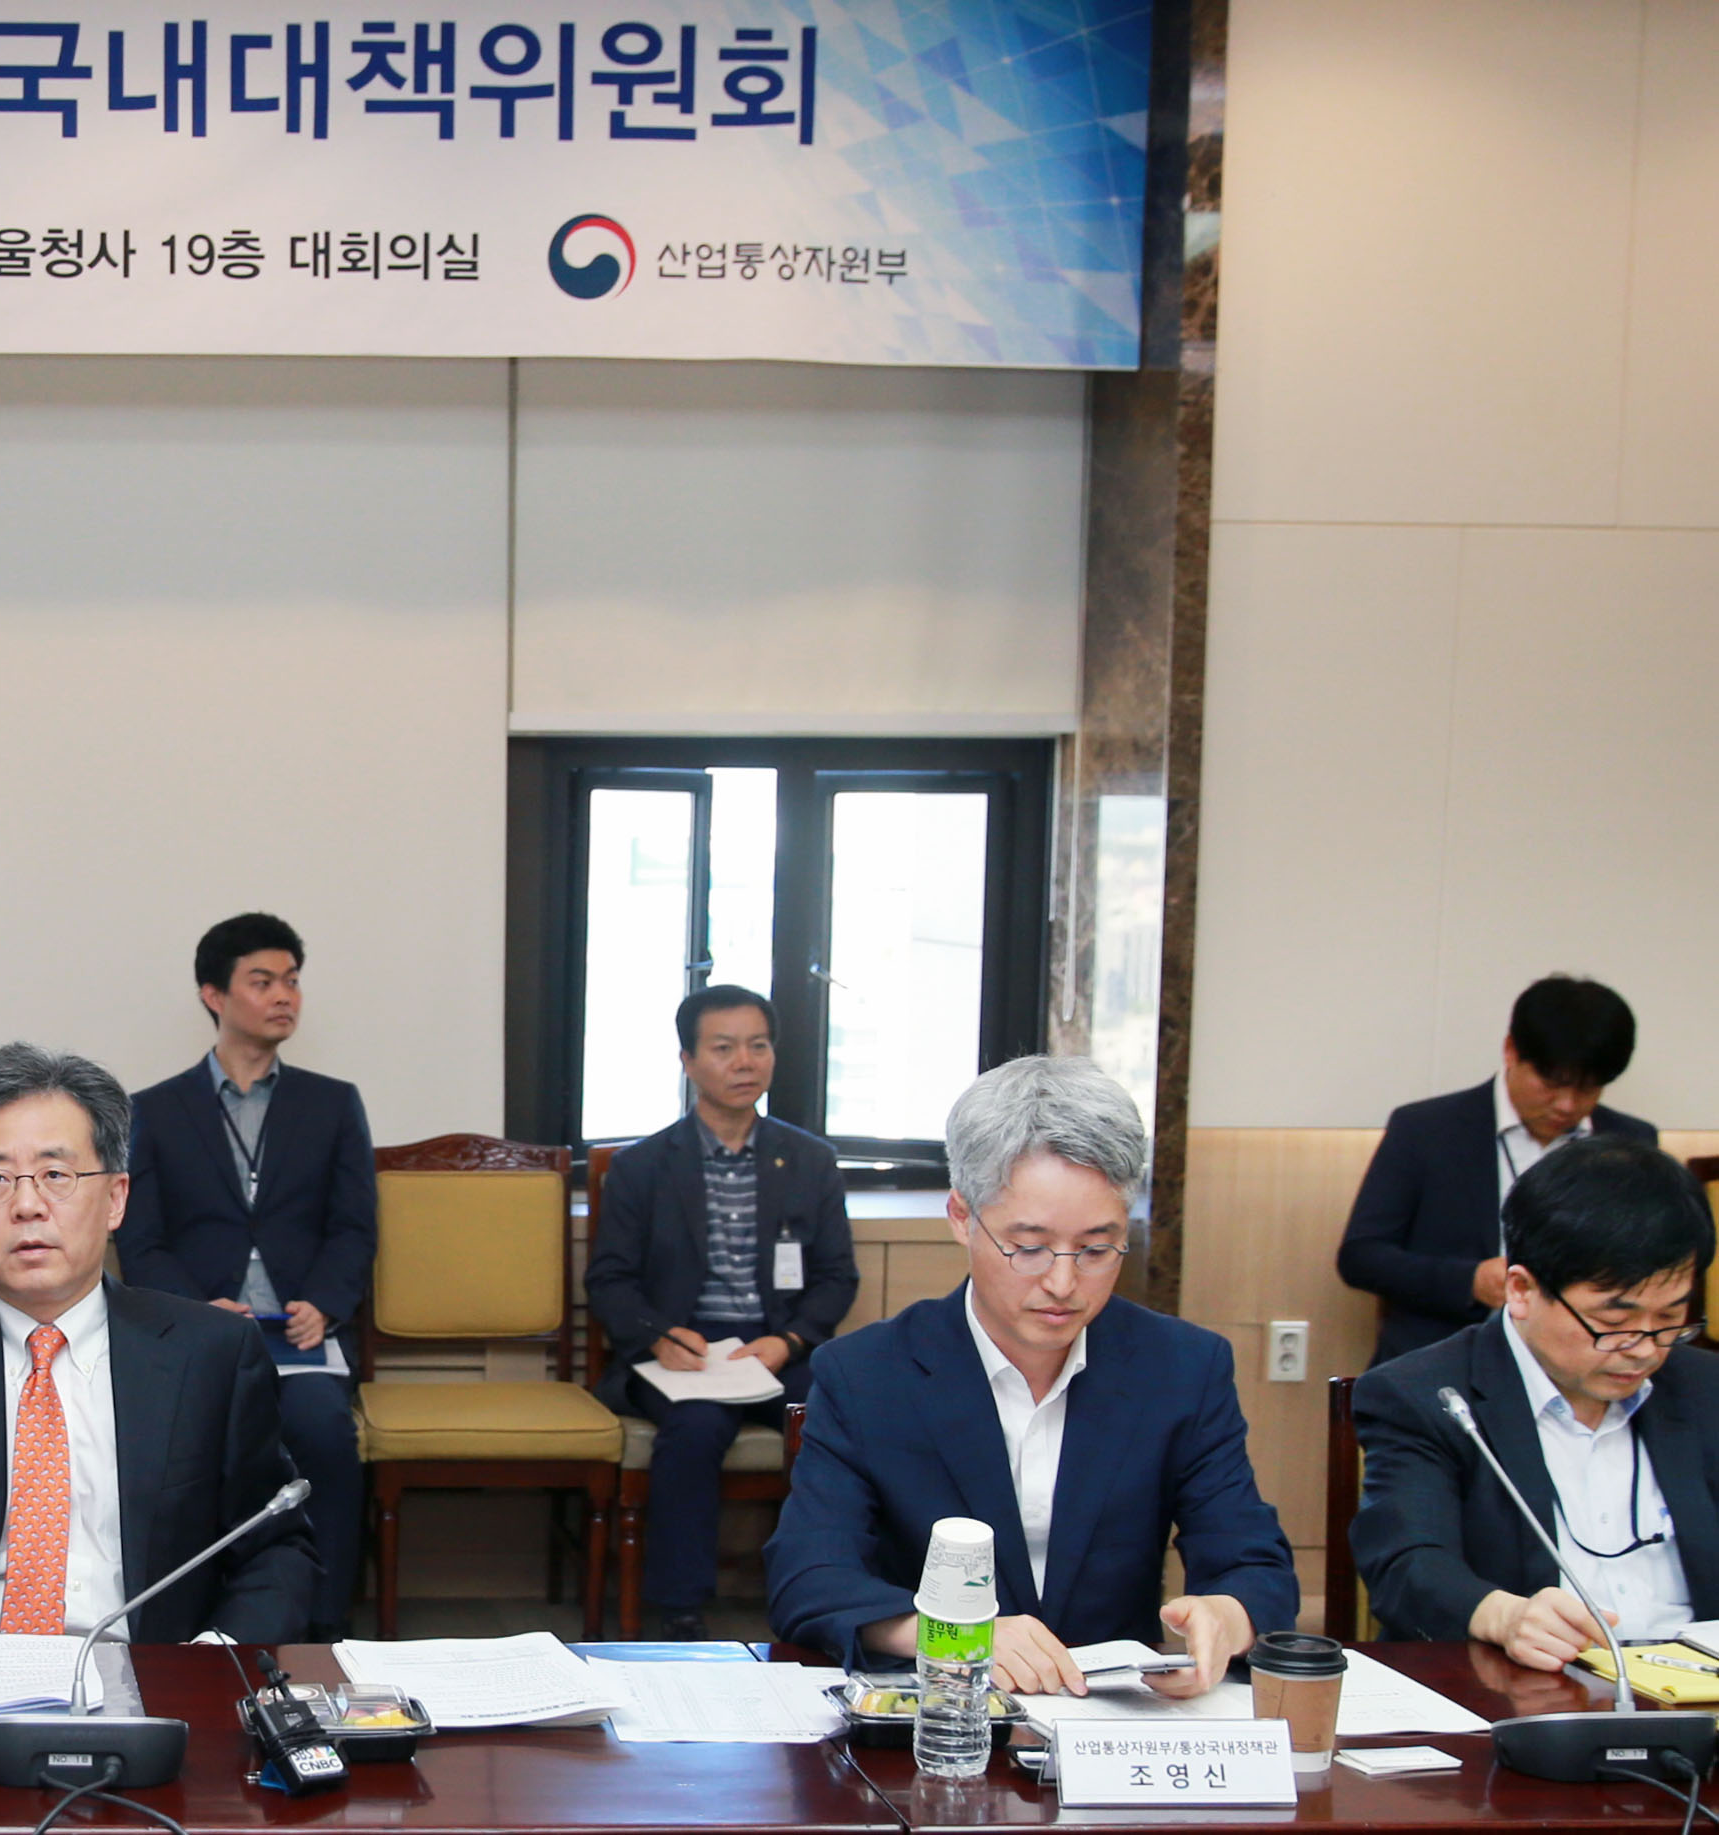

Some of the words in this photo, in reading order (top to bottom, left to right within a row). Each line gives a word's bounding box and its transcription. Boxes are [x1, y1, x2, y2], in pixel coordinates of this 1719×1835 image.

[161, 230, 265, 280] 19층
[290, 231, 480, 281] 대회의실
[656, 241, 909, 286] 산업통상자원부
[299, 1758, 341, 1772] CNBC
